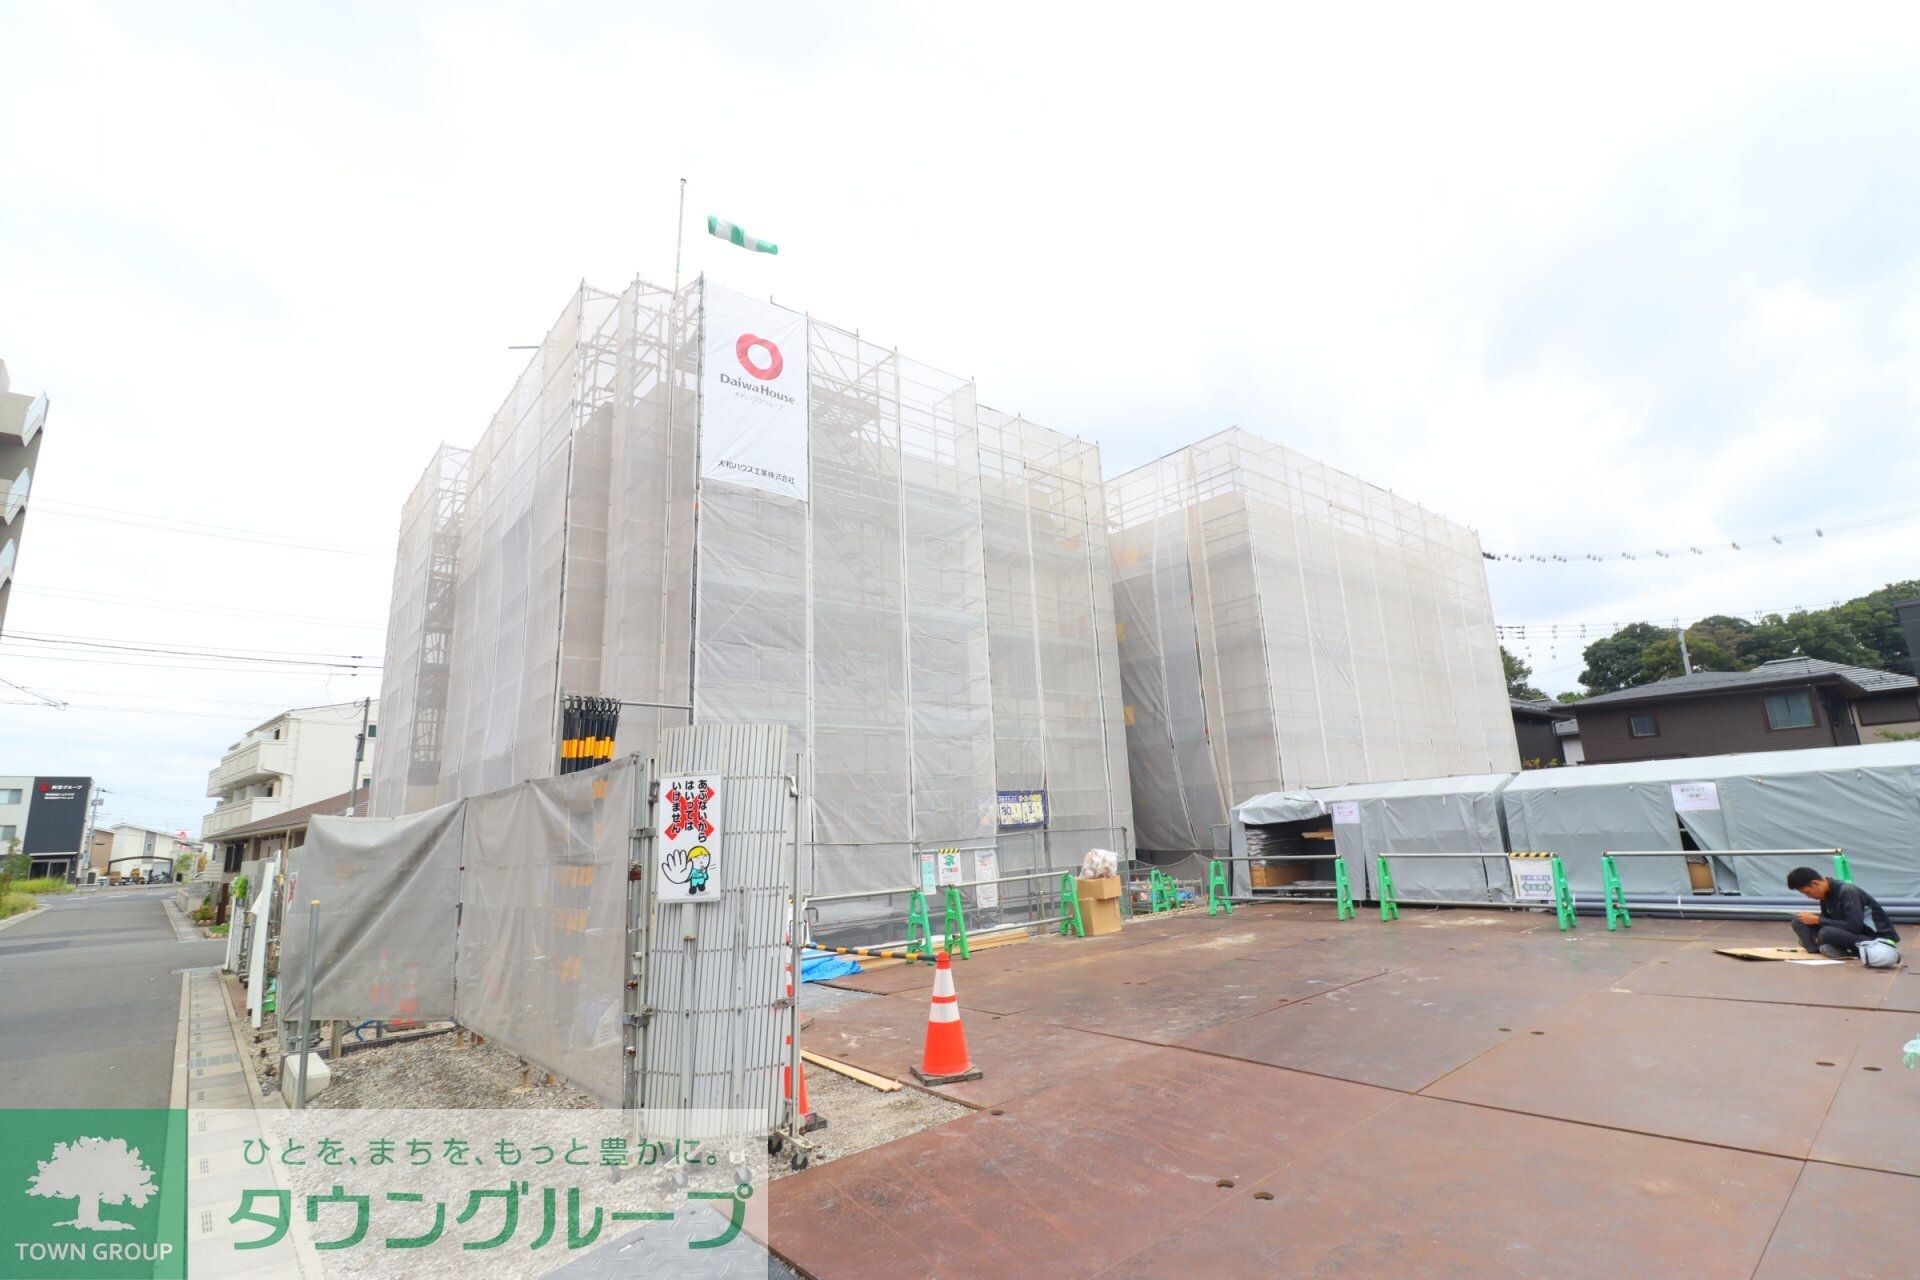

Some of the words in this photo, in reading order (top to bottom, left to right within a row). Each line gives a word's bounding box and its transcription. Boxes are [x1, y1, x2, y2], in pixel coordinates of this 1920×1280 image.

[718, 459, 795, 485] 大和ハウス工業株式会社
[672, 781, 682, 833] いけません
[685, 780, 695, 831] はいっては
[698, 780, 708, 843] あぶないから
